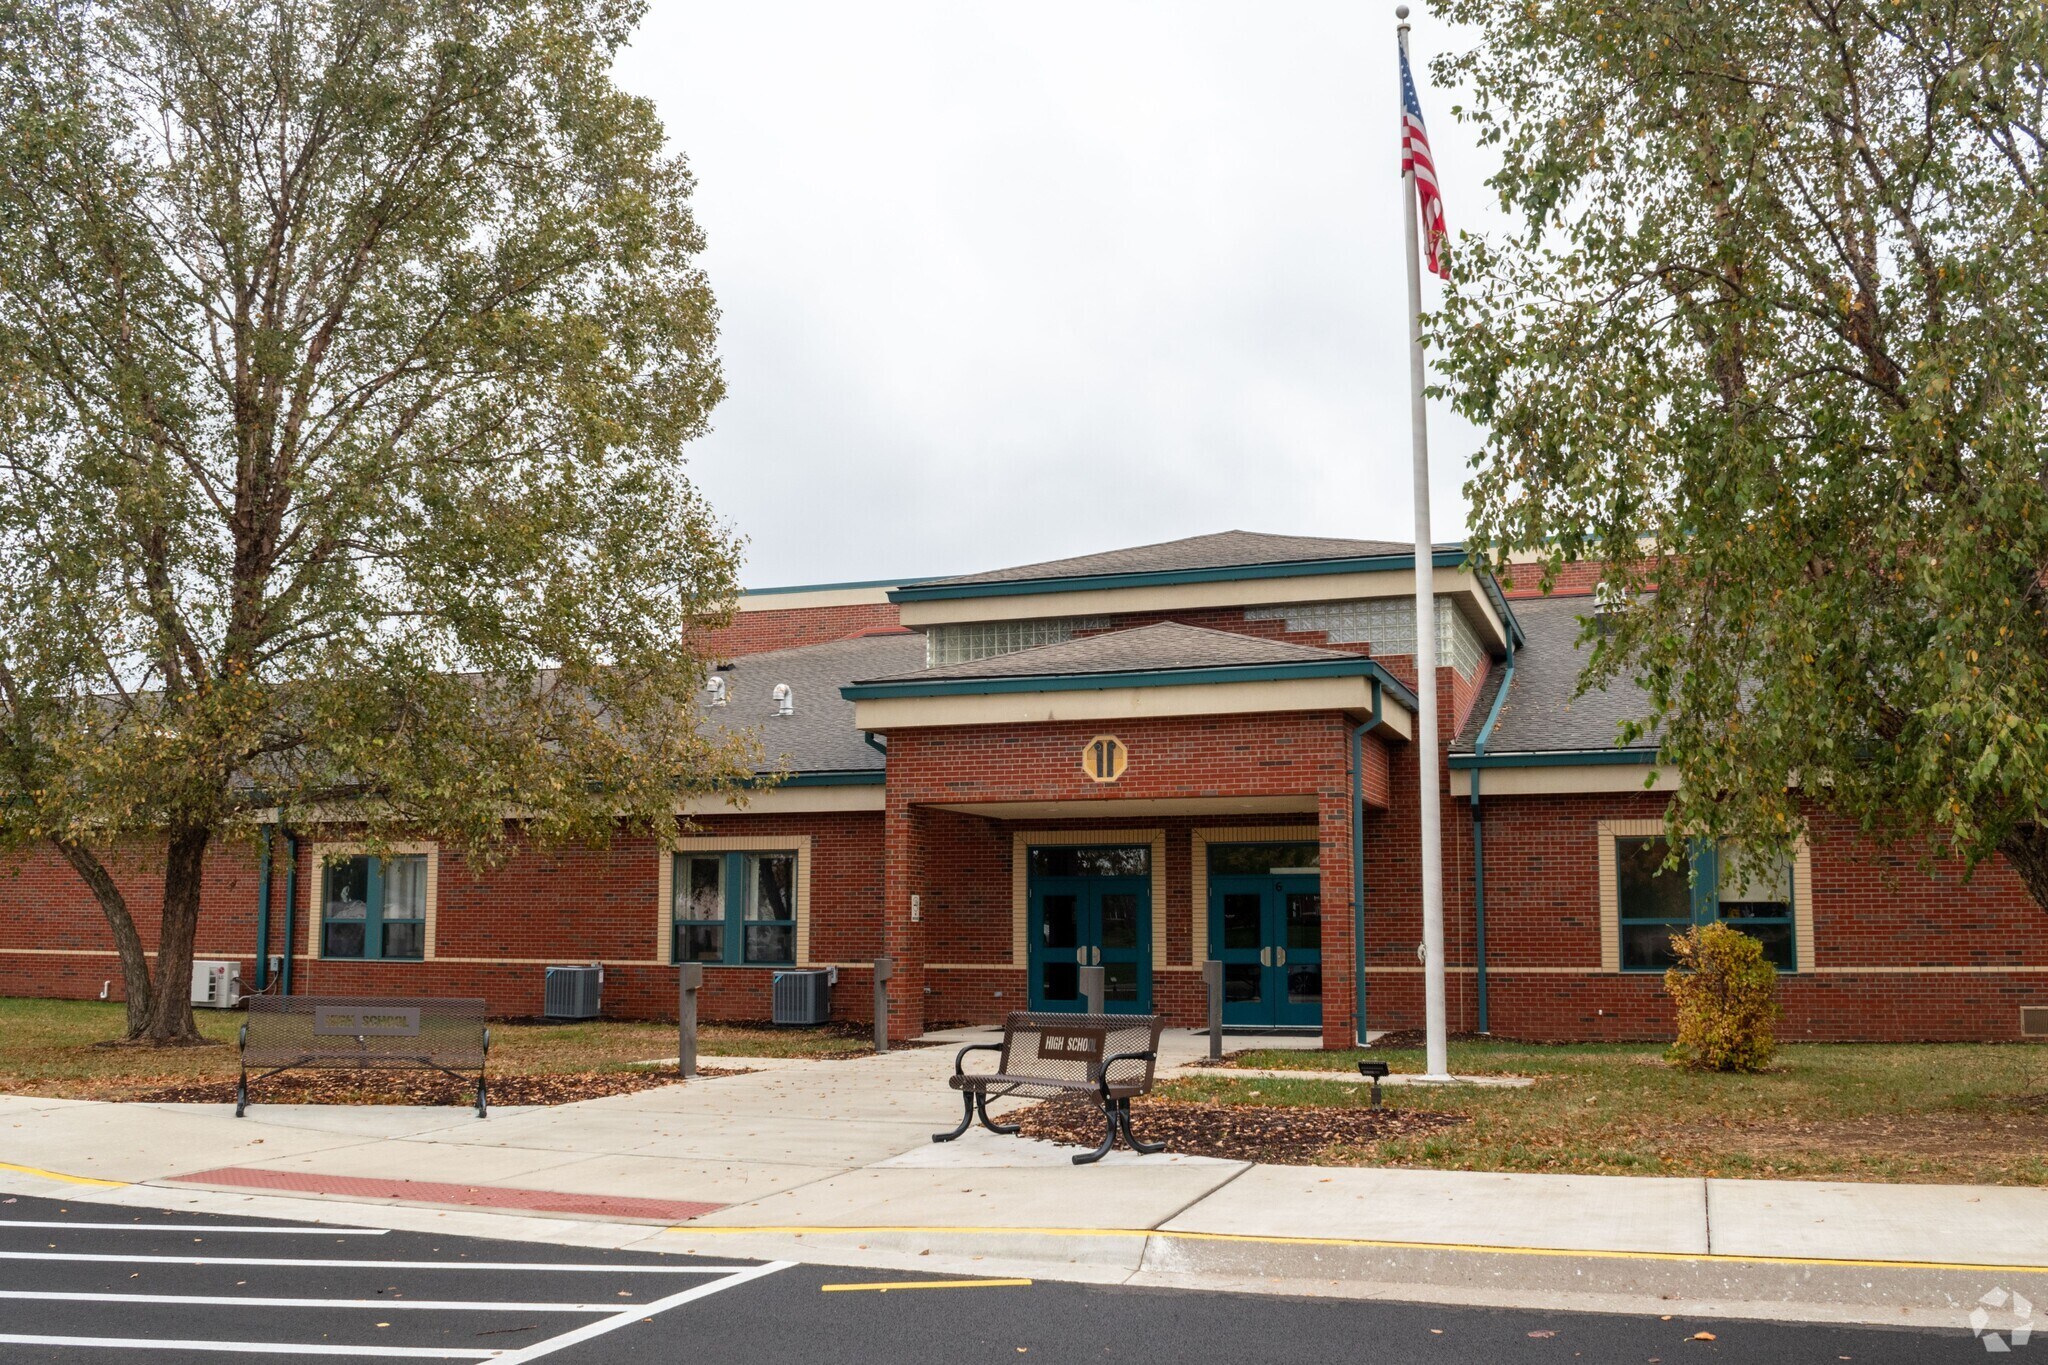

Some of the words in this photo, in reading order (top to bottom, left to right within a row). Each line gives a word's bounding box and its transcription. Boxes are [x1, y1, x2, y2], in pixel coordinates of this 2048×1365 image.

[325, 1014, 355, 1028] HIGH
[361, 1015, 409, 1029] SCHOOL
[1045, 1036, 1065, 1050] HIGH
[1067, 1037, 1097, 1052] SCHOOL
